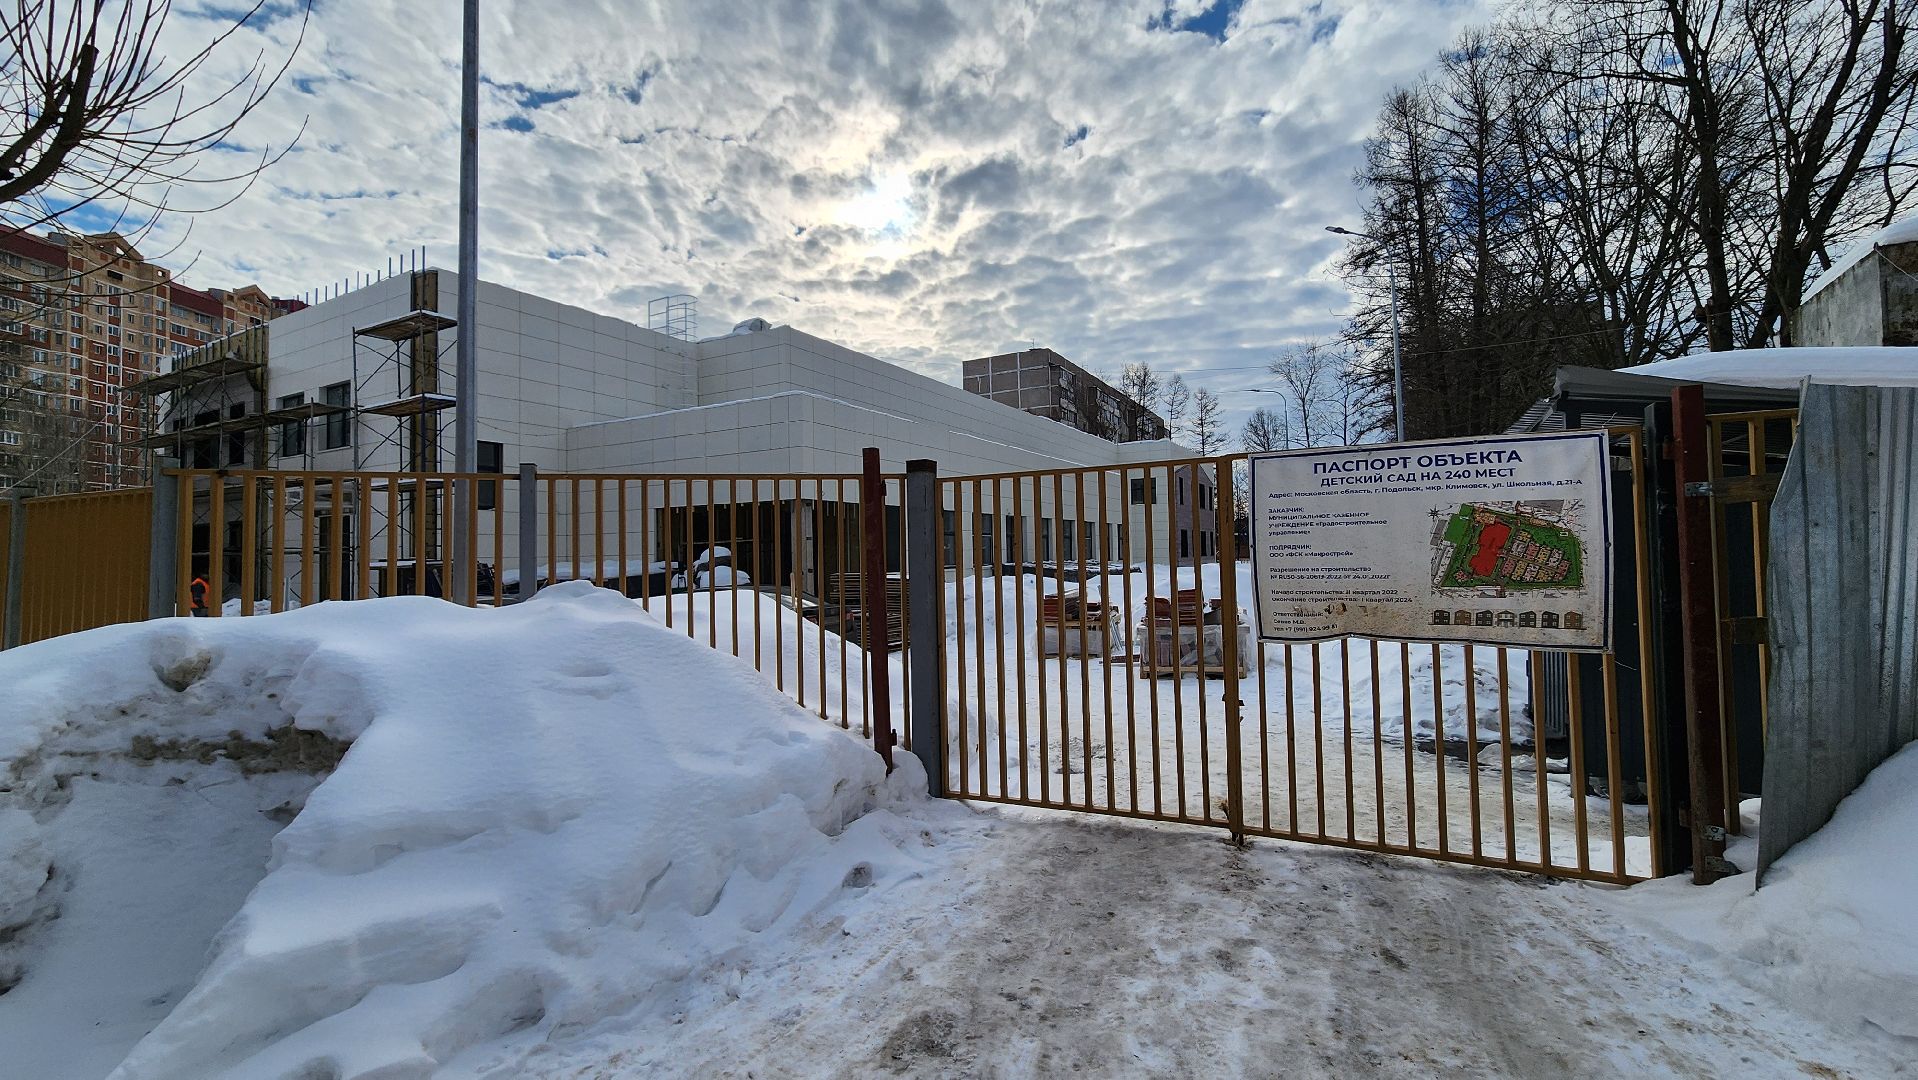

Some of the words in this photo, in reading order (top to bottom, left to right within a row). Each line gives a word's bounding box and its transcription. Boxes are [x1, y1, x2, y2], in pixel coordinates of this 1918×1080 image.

[1313, 456, 1412, 474] ПАСПОРТ
[1417, 449, 1523, 468] ОБЪЕКТА
[1320, 473, 1383, 487] ДЕТСКИЙ
[1386, 472, 1417, 482] САД
[1420, 471, 1441, 481] НА
[1444, 469, 1471, 480] 240
[1475, 467, 1516, 478] МЕСТ
[1381, 485, 1423, 493] Подольск,
[1445, 482, 1490, 490] Климовск,
[1506, 480, 1555, 488] Школьная,
